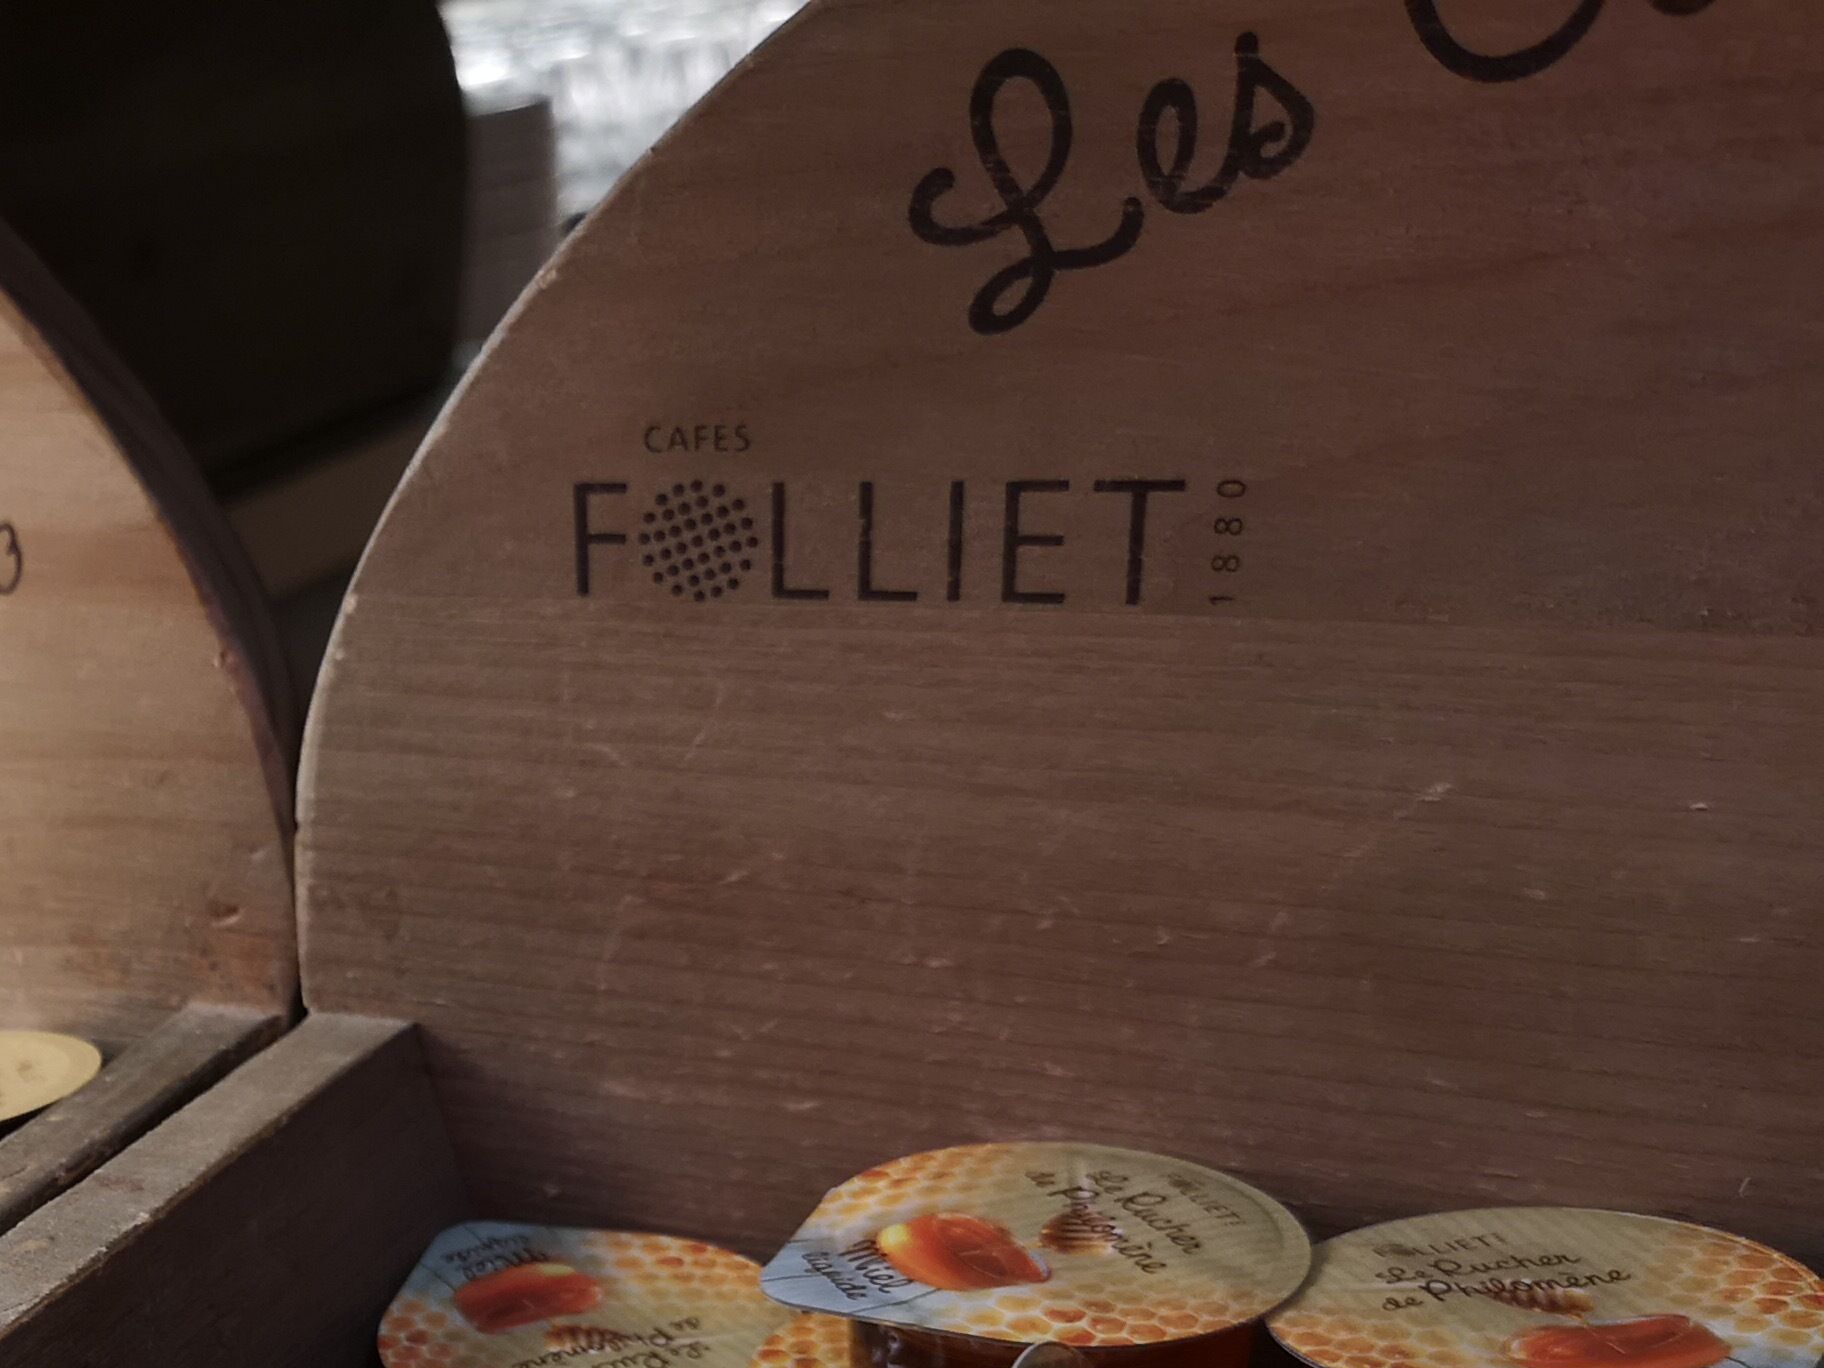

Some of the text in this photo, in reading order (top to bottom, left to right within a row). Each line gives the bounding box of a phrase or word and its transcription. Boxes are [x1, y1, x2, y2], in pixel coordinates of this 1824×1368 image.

[908, 31, 1316, 336] Les
[643, 422, 754, 456] CAFES
[572, 478, 1187, 606] FOLLIET
[1209, 478, 1249, 607] 1880
[839, 1239, 915, 1296] Miel
[1380, 1265, 1633, 1313] de Philomène
[1436, 1251, 1583, 1281] Rucher
